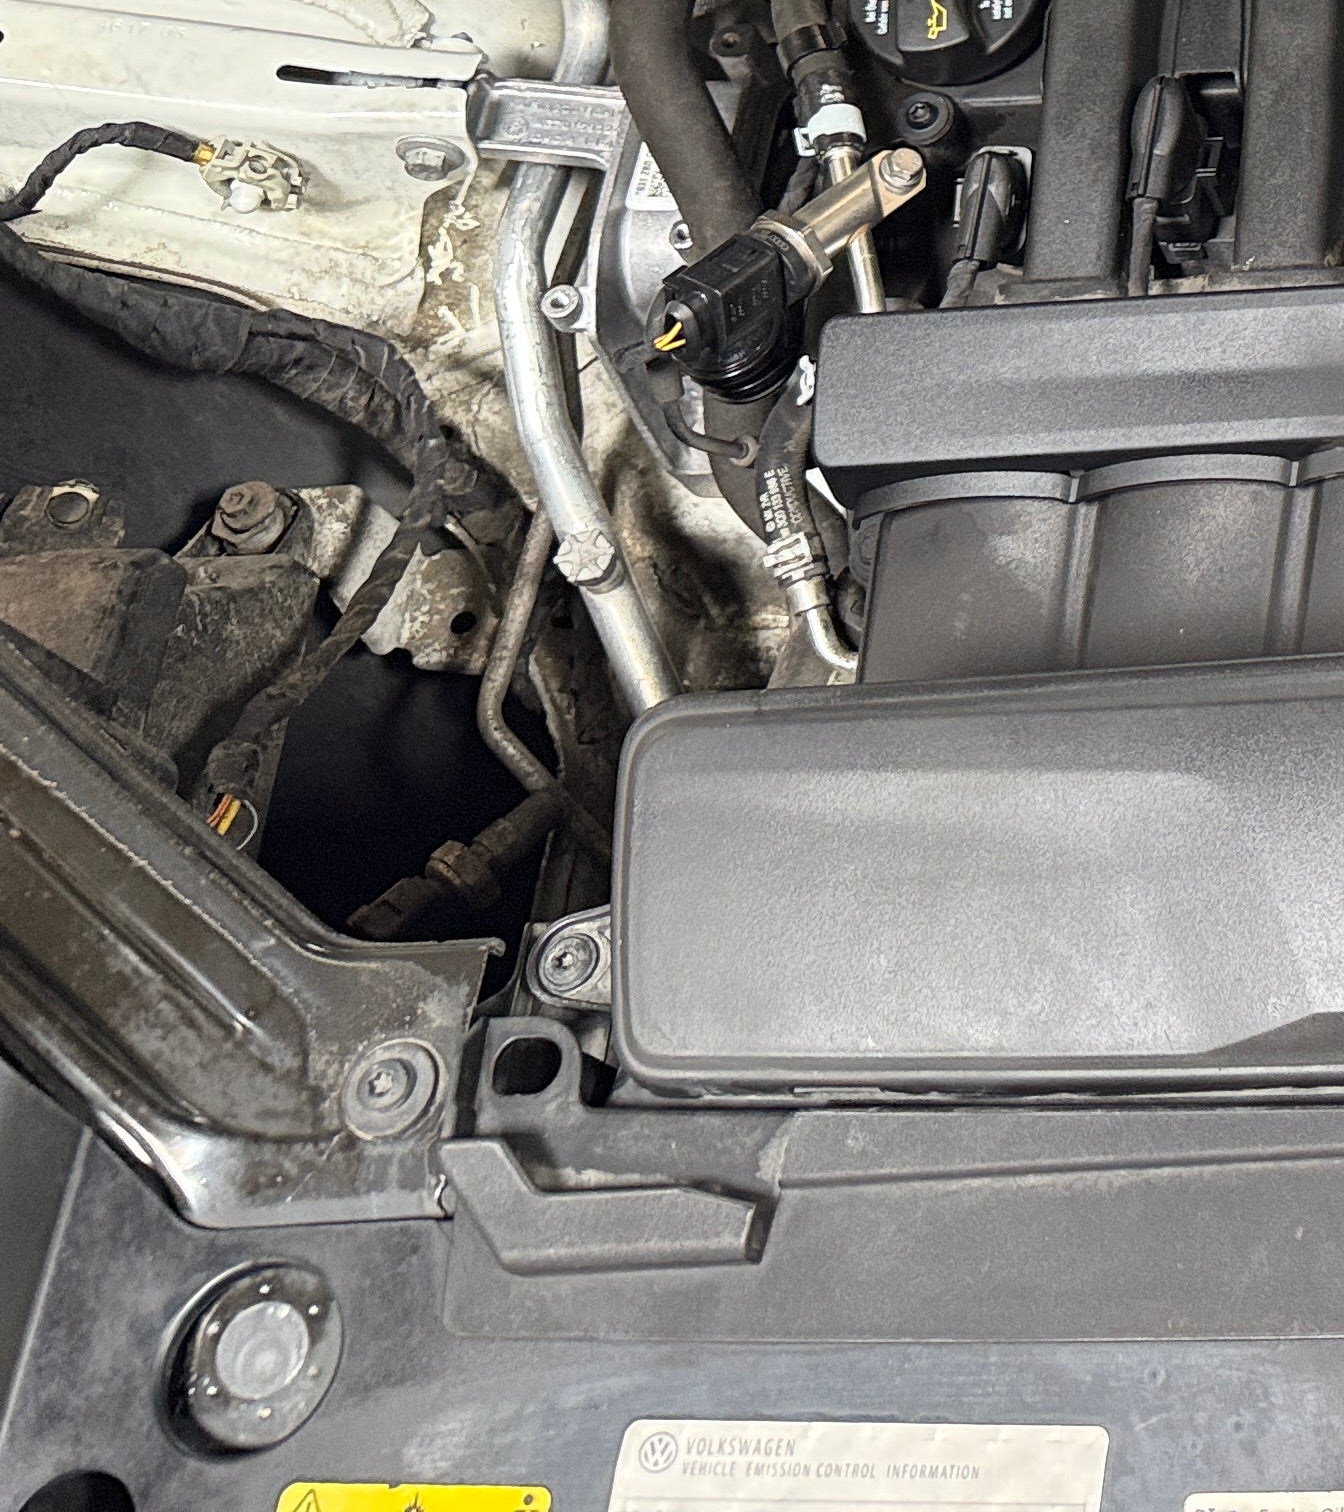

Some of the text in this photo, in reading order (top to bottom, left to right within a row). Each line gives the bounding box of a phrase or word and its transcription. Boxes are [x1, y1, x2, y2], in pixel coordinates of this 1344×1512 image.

[686, 1438, 797, 1457] VOLKSWAGEN
[682, 1461, 980, 1481] VEHICLE EMISSION CONTROL INFORMATION
